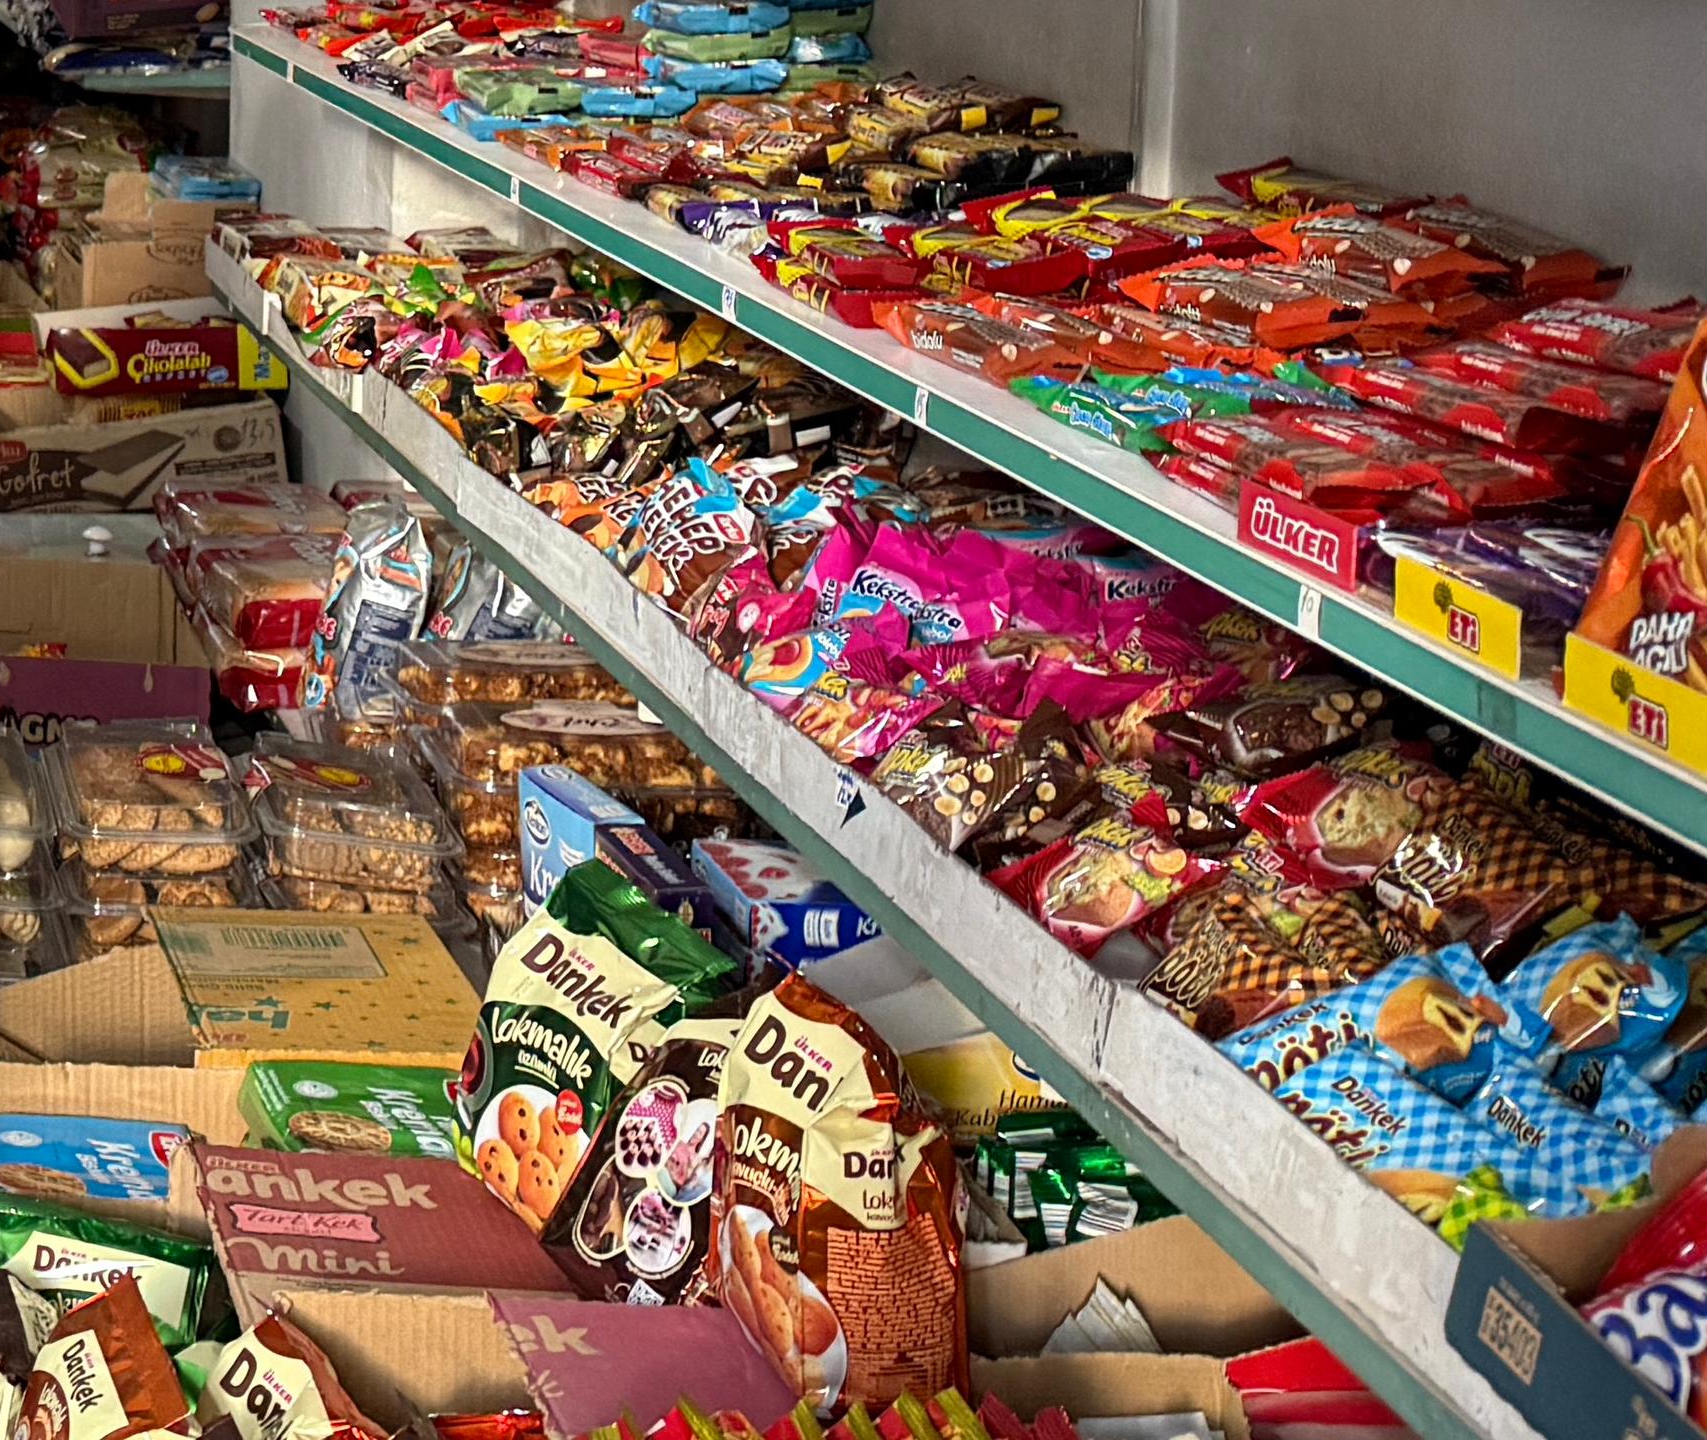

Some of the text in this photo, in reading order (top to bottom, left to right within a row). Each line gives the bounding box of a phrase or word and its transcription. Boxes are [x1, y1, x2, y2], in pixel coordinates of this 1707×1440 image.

[1249, 495, 1341, 575] ÜLKER
[1448, 608, 1478, 649] ETi
[1629, 611, 1695, 650] DAHA
[1630, 698, 1668, 747] ETi
[521, 932, 633, 1030] Dankek
[568, 945, 597, 972] ÜLKER
[491, 1005, 594, 1092] Lokmalık
[743, 1013, 839, 1113] Dan
[793, 1034, 834, 1074] ÜLKER
[1331, 1071, 1410, 1137] Dankek
[1488, 1095, 1548, 1151] Dankek
[206, 1167, 440, 1212] ankek
[63, 1338, 100, 1415] Dankek
[262, 1371, 295, 1405] ÜLKER
